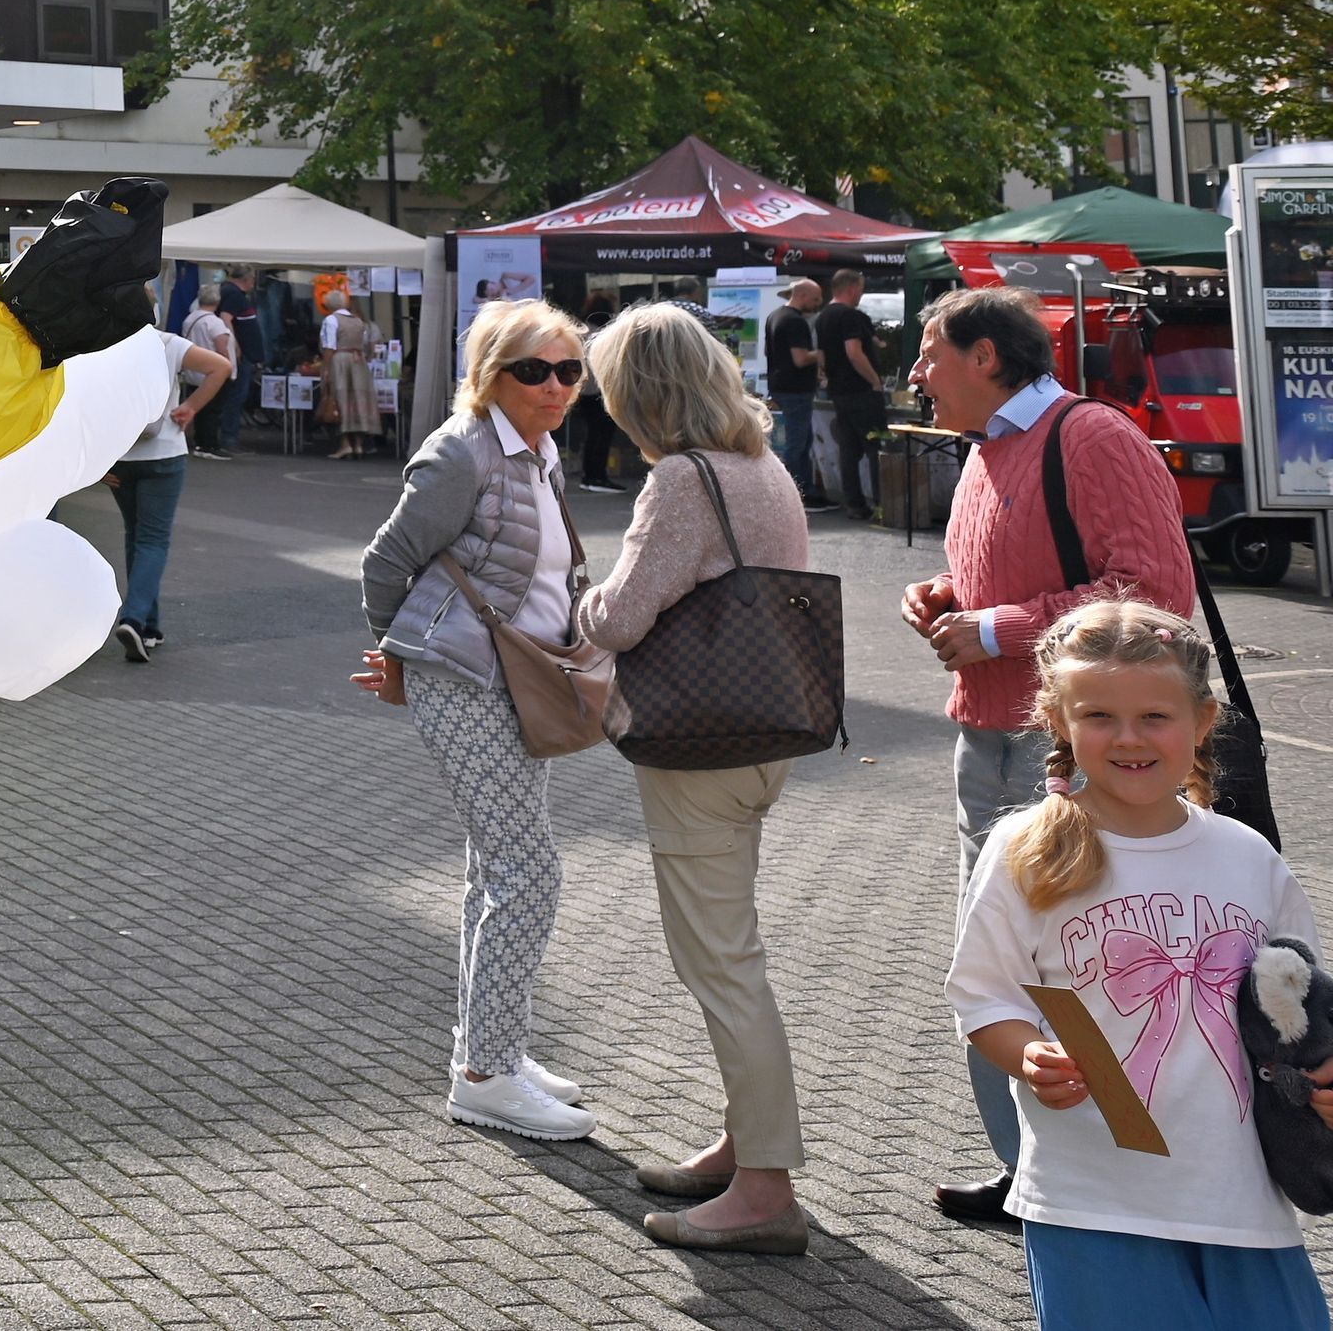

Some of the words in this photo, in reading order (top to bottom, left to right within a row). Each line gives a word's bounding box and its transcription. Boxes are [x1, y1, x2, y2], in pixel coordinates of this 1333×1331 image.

[1260, 191, 1306, 204] SIMON
[597, 244, 712, 262] www.expotrade.at
[1283, 357, 1333, 376] KUL
[1284, 379, 1333, 399] NA
